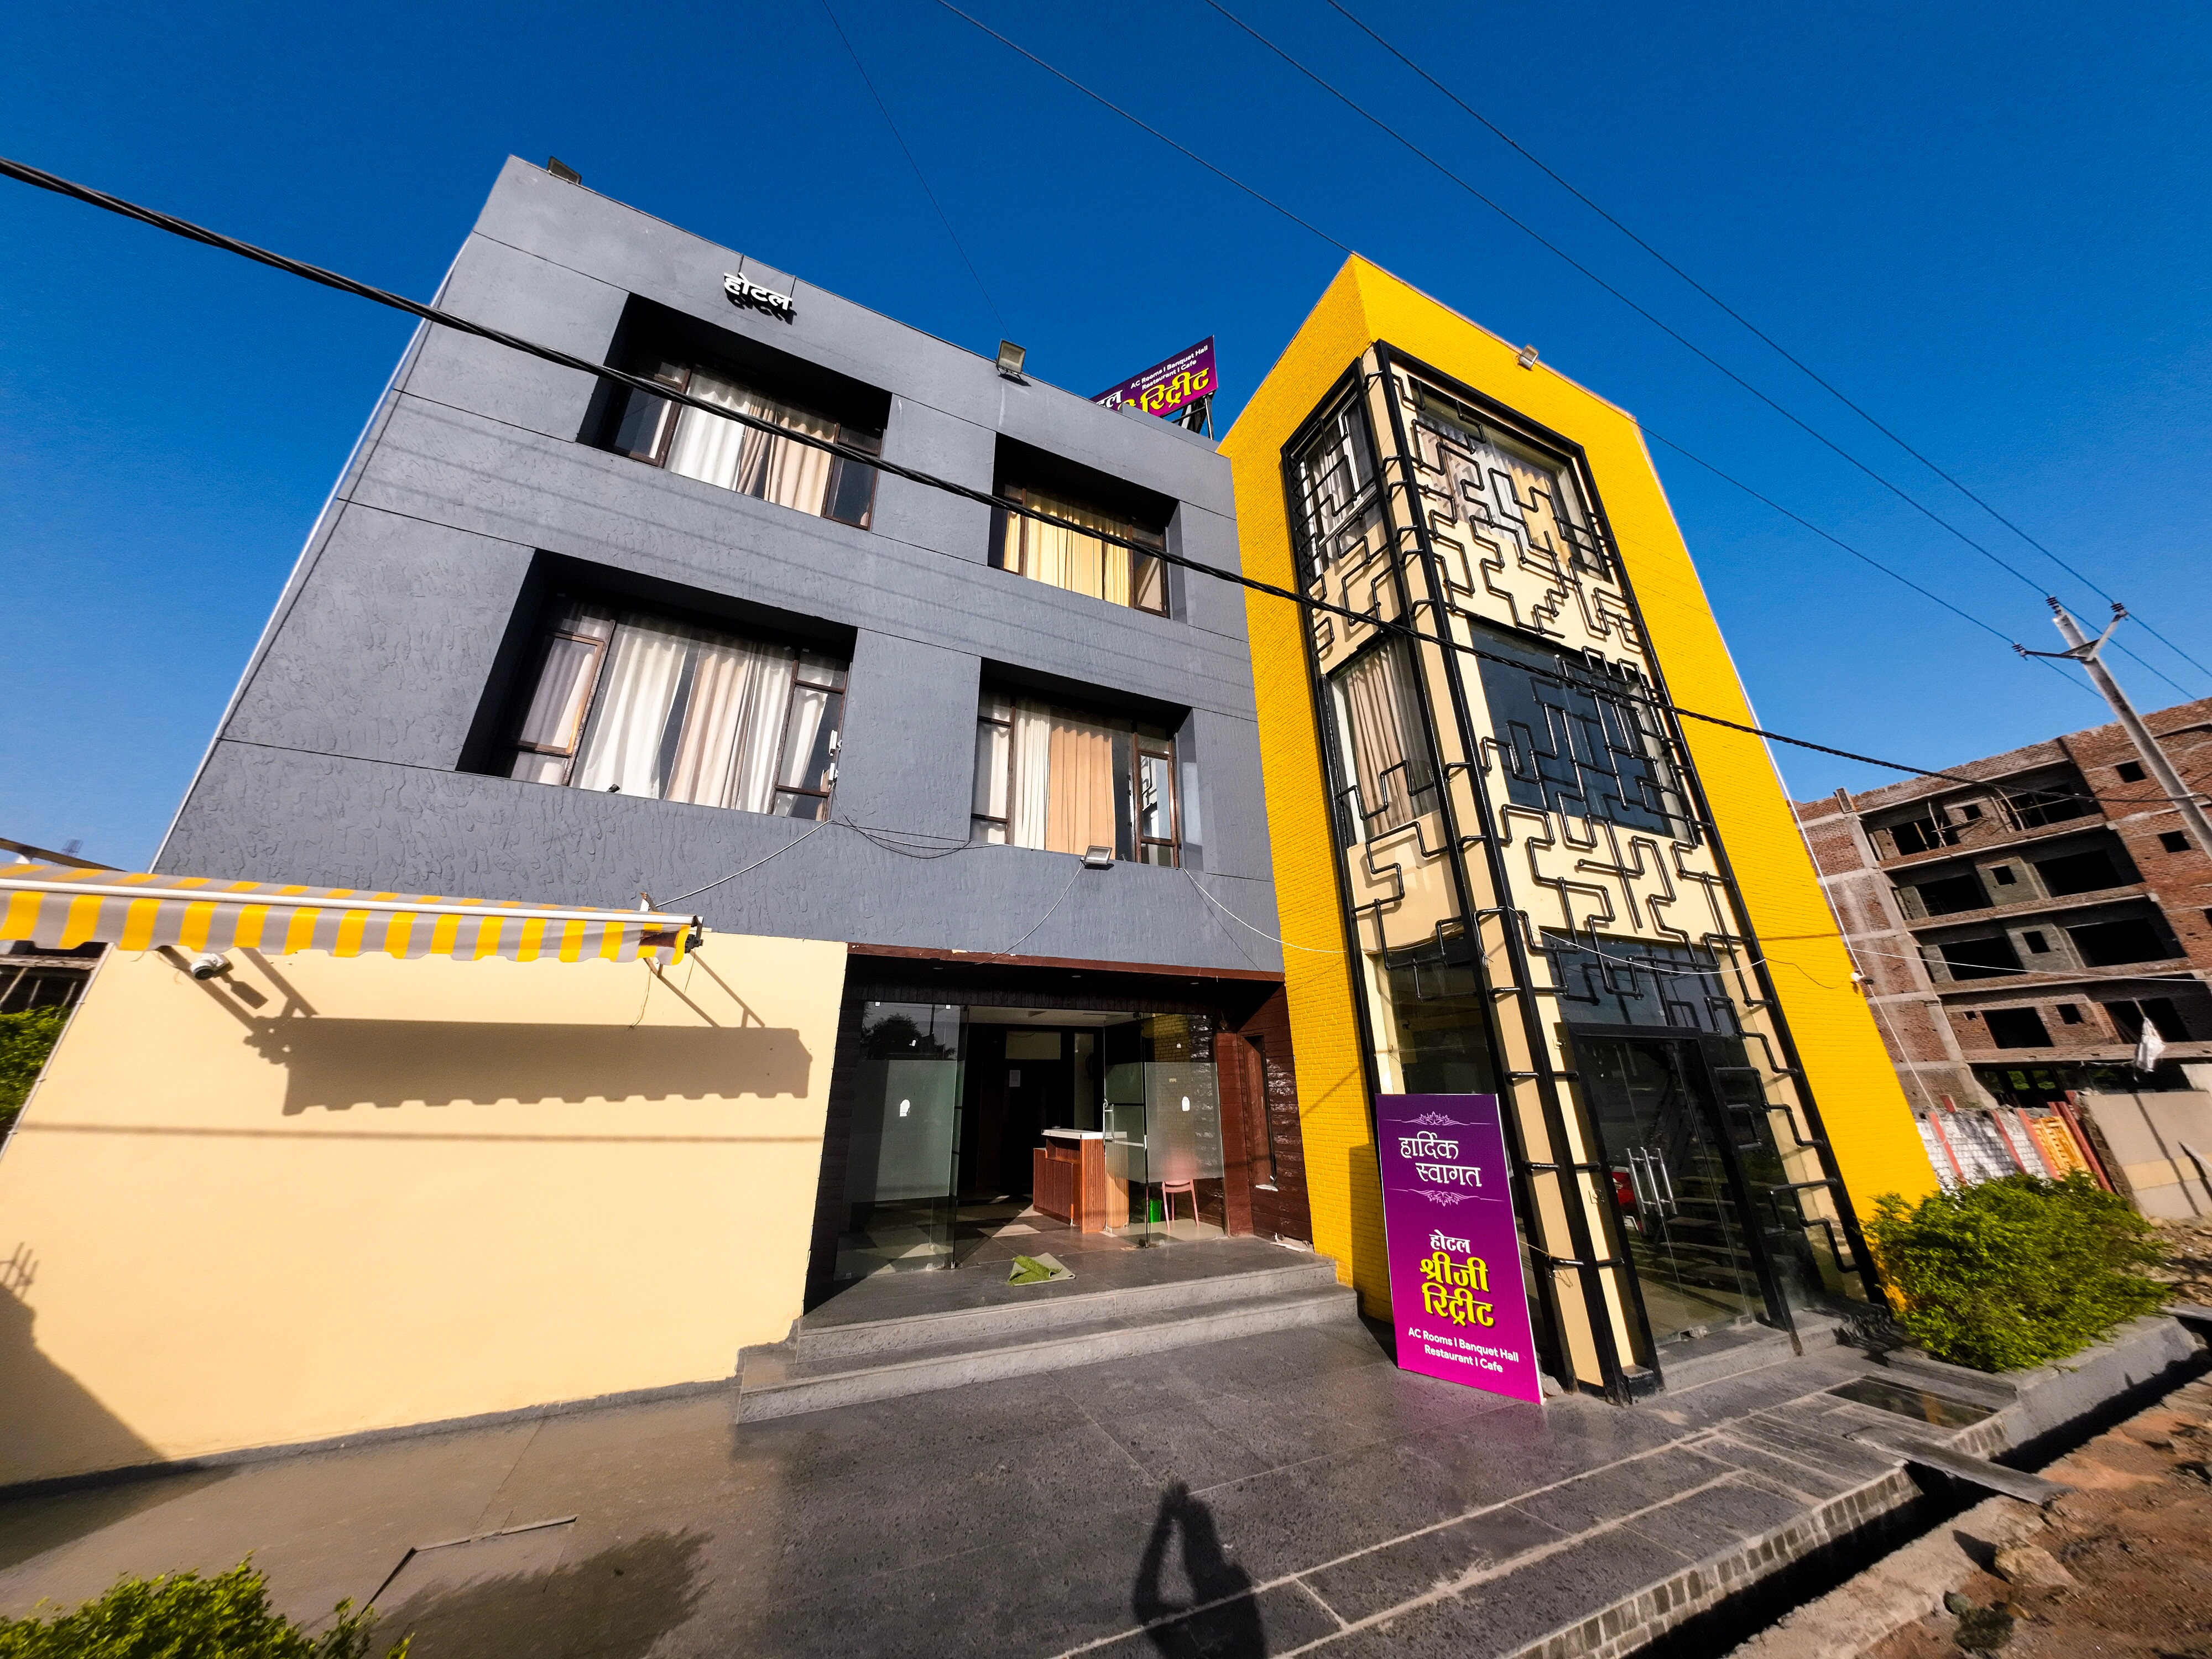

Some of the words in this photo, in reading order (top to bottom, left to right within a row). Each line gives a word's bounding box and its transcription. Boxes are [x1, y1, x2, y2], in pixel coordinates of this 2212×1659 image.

[724, 272, 792, 310] होटल
[1131, 380, 1140, 389] AC
[1141, 369, 1162, 384] Rooms
[1167, 353, 1194, 370] Banquet
[1195, 345, 1208, 356] Hall
[1142, 369, 1176, 390] Restaurant
[1181, 360, 1197, 371] Cafe
[1140, 367, 1209, 413] रिट्रीट
[1399, 1131, 1459, 1160] हार्दिक
[1415, 1162, 1482, 1187] स्वागत
[1429, 1229, 1470, 1254] होटल
[1420, 1251, 1489, 1292] श्रीजी
[1421, 1282, 1494, 1327] रिट्रीट
[1408, 1327, 1421, 1338] AC
[1423, 1331, 1453, 1346] Rooms
[1459, 1338, 1499, 1357] Banquet
[1500, 1348, 1519, 1363] Hall
[1425, 1344, 1474, 1365] Restaurant
[1480, 1358, 1503, 1373] Cafe
